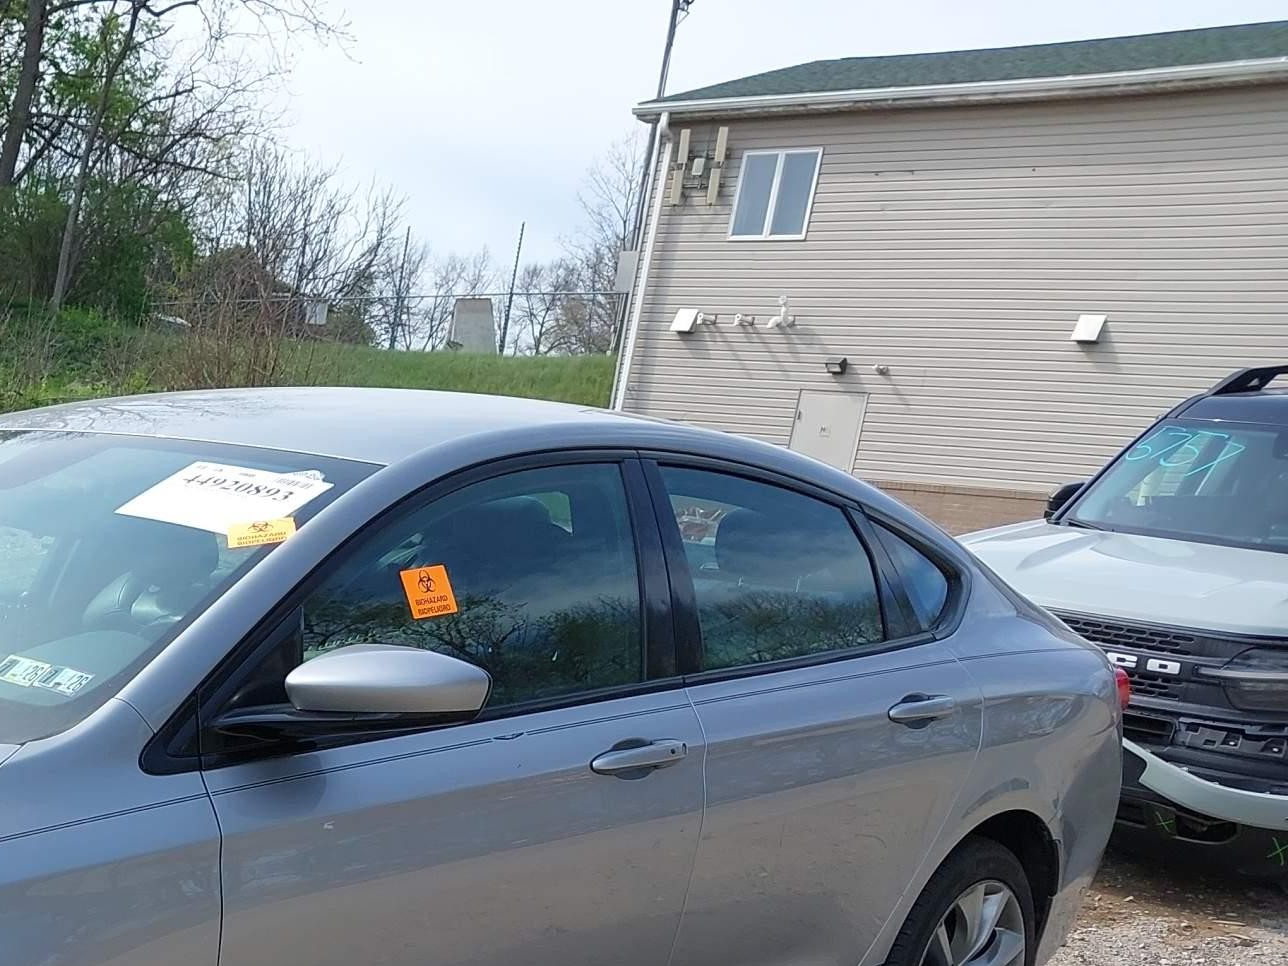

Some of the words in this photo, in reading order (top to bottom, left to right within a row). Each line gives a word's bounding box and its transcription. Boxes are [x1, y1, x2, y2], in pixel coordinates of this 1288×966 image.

[183, 473, 295, 502] 44920893
[236, 531, 287, 541] BIOHAZARD
[415, 594, 449, 606] BIOHAZARD
[418, 603, 451, 616] BIOPELIGRO
[66, 674, 89, 692] 26
